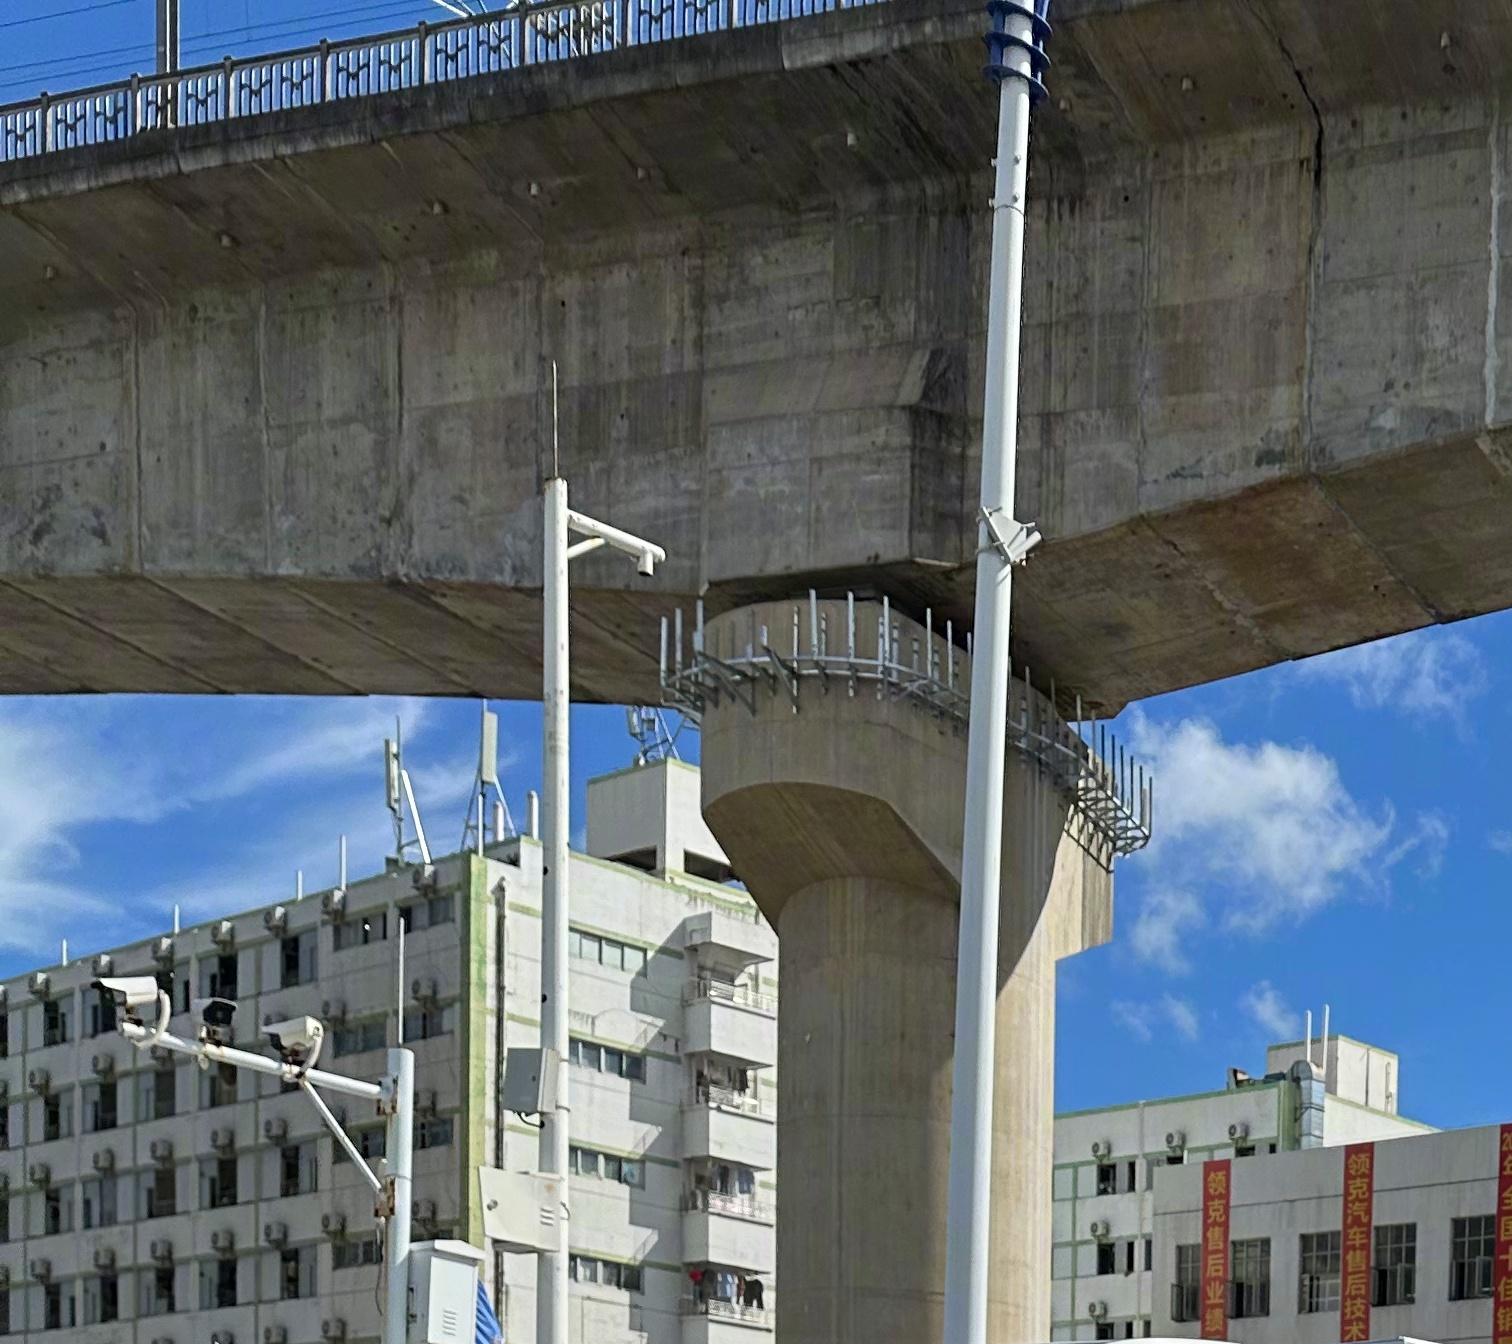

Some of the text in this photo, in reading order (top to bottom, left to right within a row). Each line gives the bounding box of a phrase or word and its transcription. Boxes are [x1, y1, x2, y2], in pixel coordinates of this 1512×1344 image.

[1205, 1170, 1227, 1332] 领克售后业绩
[1344, 1152, 1371, 1341] 领克汽车售后技术
